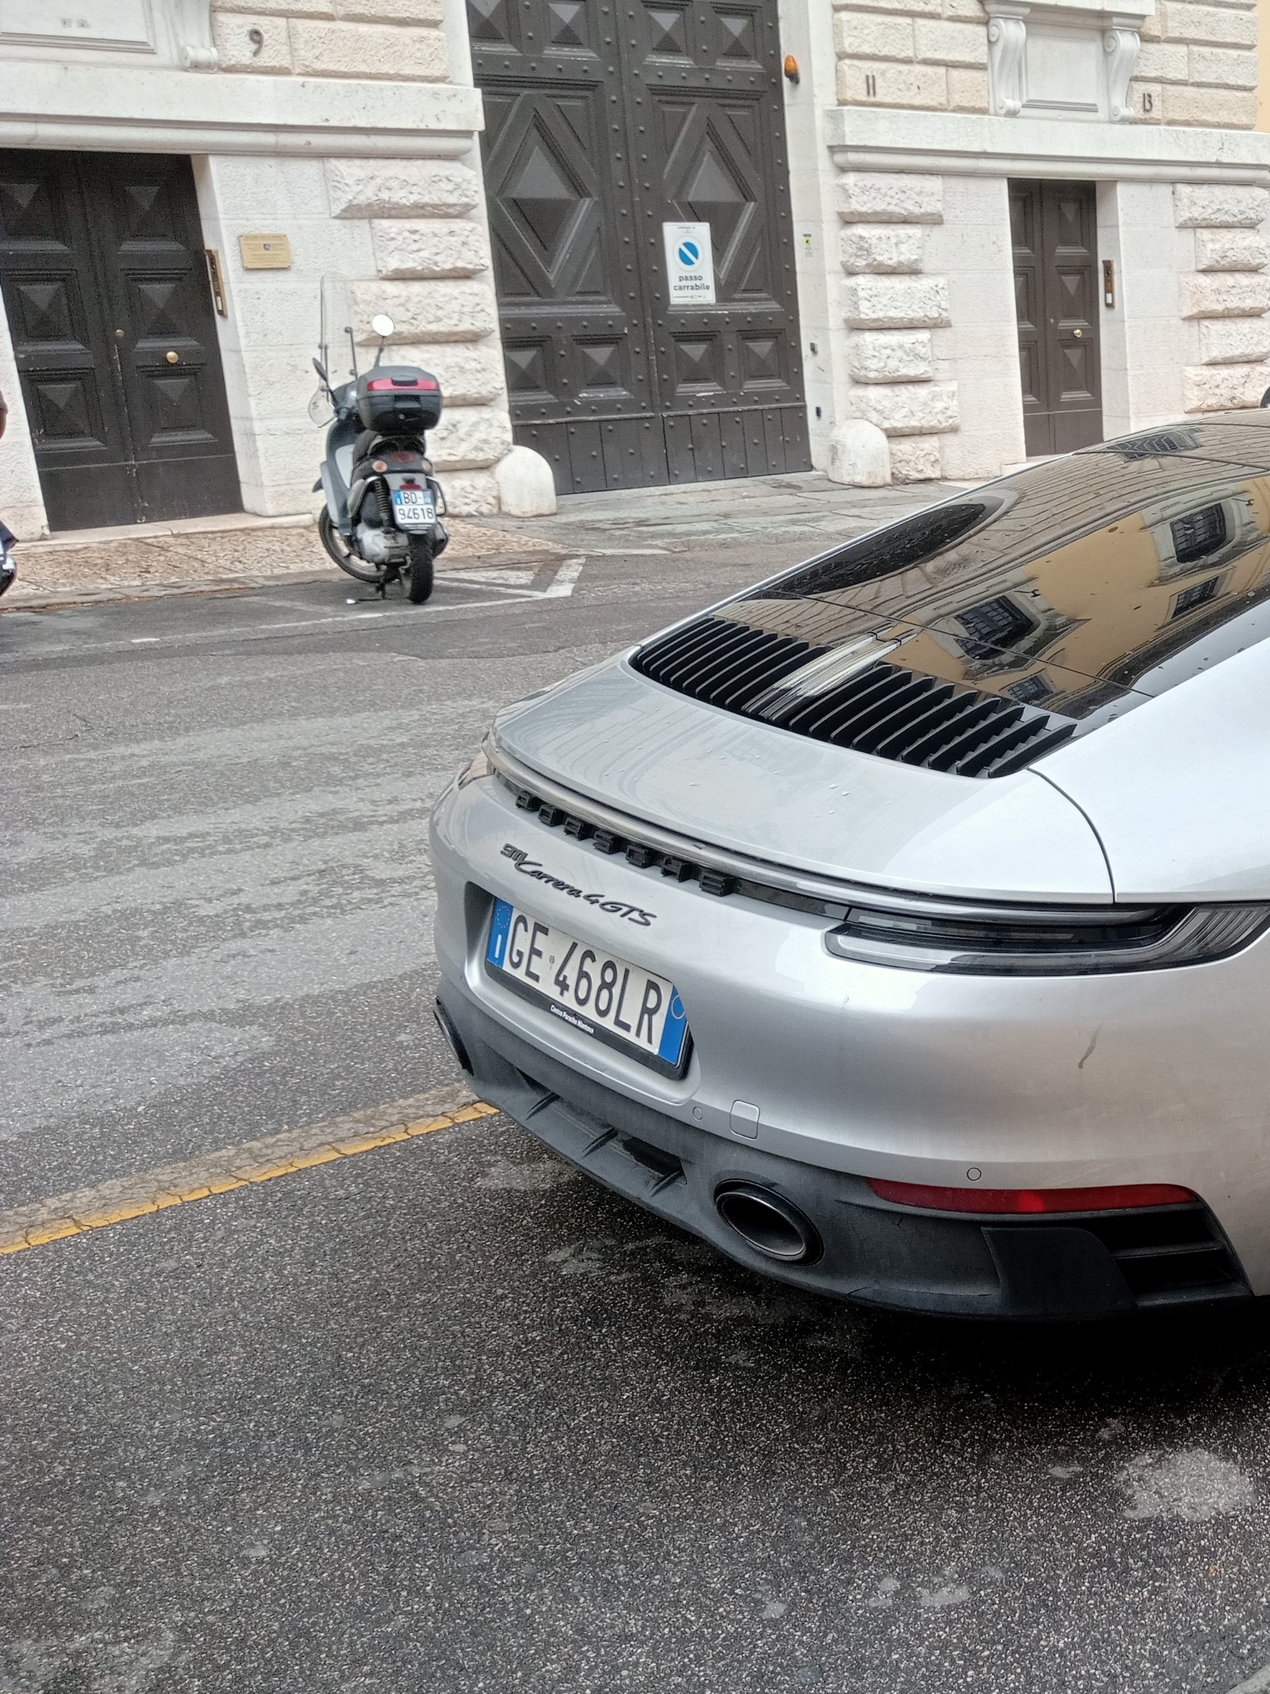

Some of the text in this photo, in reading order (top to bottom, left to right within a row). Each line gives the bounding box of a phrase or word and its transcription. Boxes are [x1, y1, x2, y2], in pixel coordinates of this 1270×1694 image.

[249, 29, 264, 57] 9
[1142, 92, 1153, 113] 13
[673, 283, 711, 291] carrabile
[678, 274, 704, 282] passo
[500, 842, 529, 863] 911
[513, 860, 658, 927] Carrera 4 GTS
[508, 914, 663, 1046] GE 468LR
